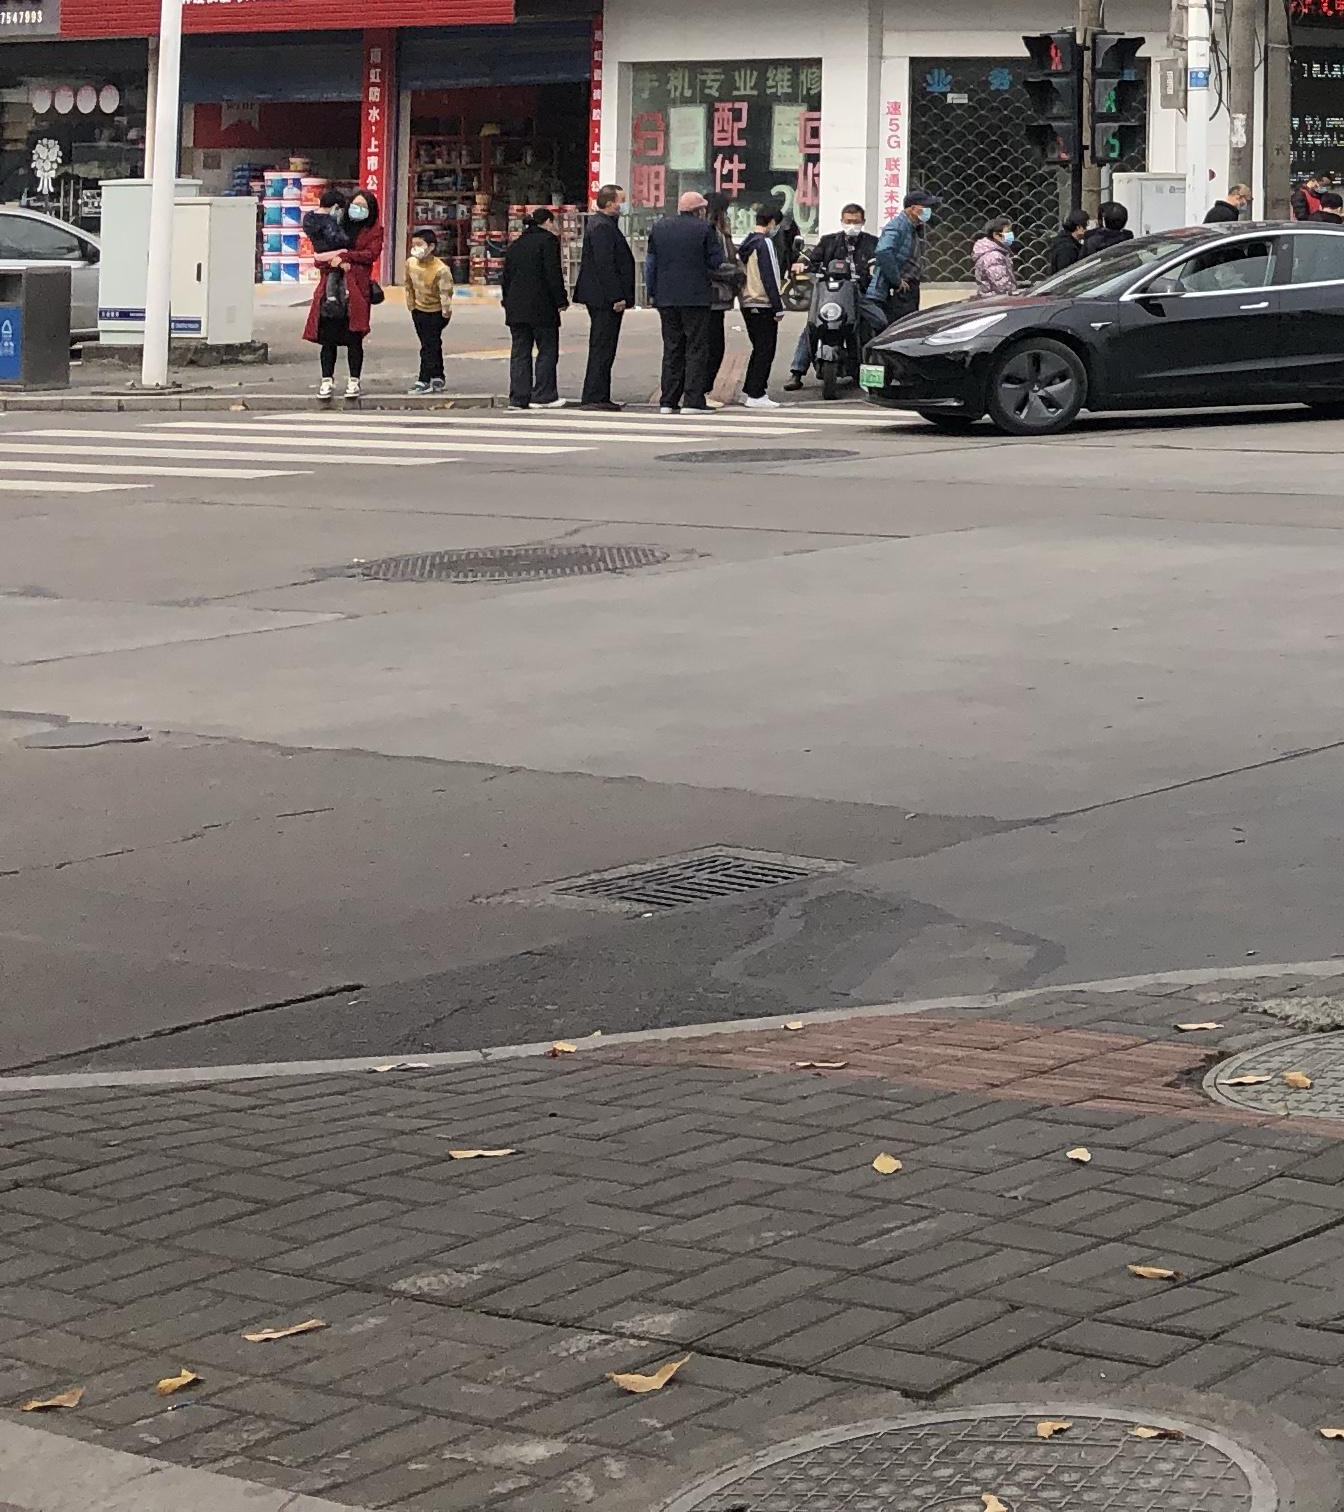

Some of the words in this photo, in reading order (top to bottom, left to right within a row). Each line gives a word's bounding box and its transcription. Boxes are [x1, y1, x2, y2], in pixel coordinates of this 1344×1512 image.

[635, 65, 821, 99] 手机专业维修
[632, 111, 666, 208] 分期
[713, 101, 749, 198] 配件
